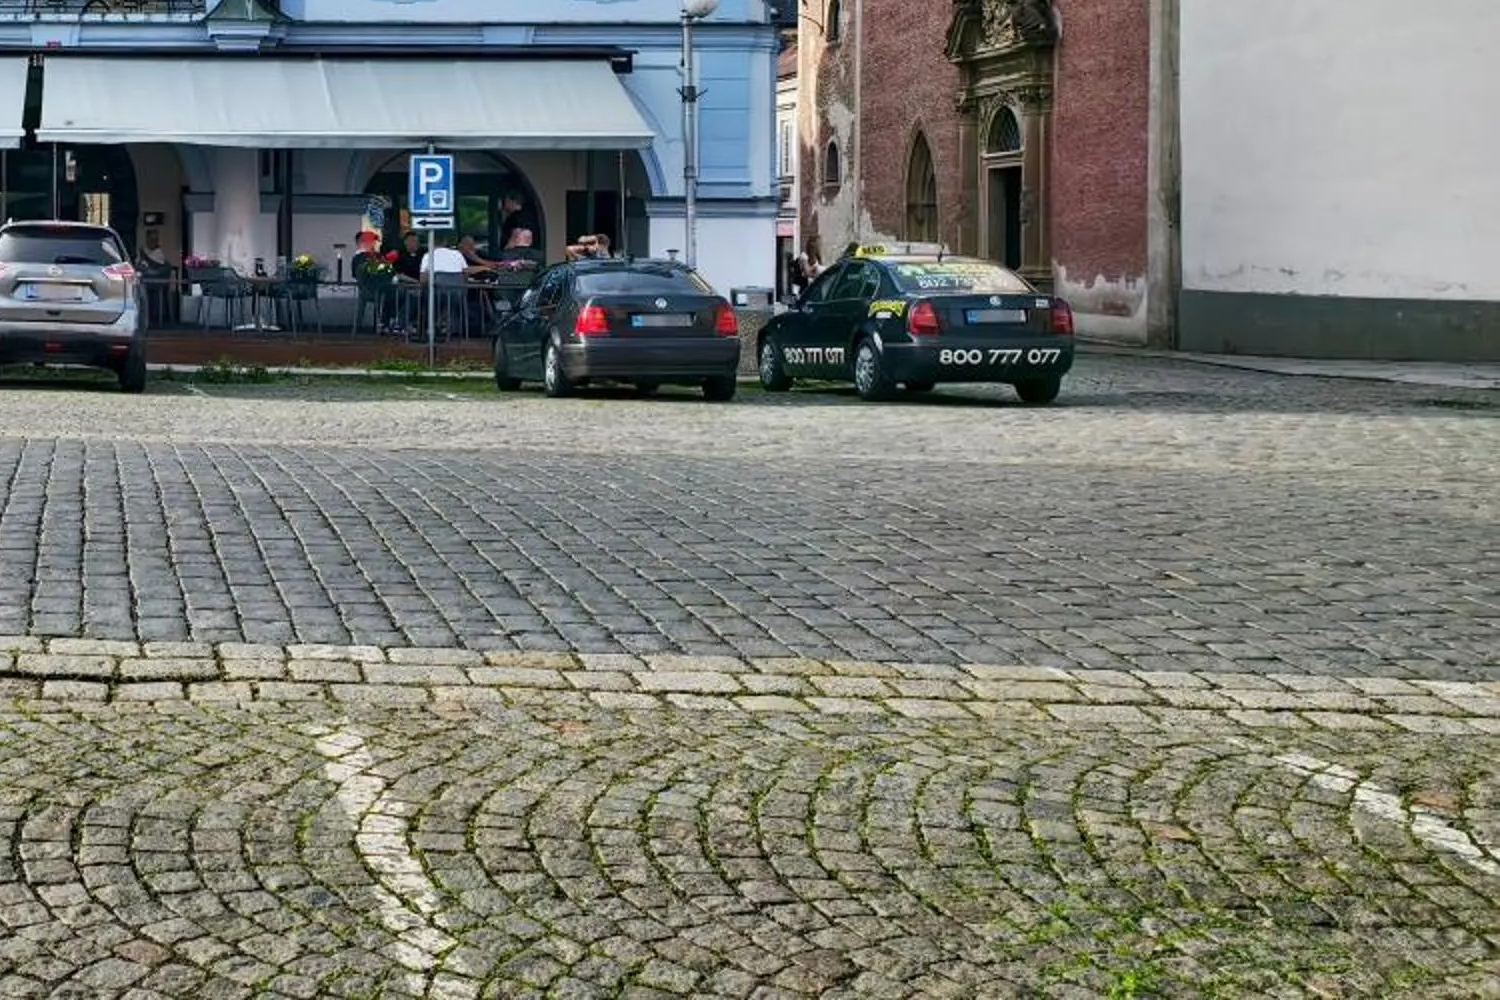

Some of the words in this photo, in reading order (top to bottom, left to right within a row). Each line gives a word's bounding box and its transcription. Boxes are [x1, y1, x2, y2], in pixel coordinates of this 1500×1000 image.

[419, 161, 444, 195] P
[784, 346, 805, 364] 800
[939, 348, 982, 366] 800
[987, 348, 1023, 365] 777
[1027, 348, 1061, 366] 077
